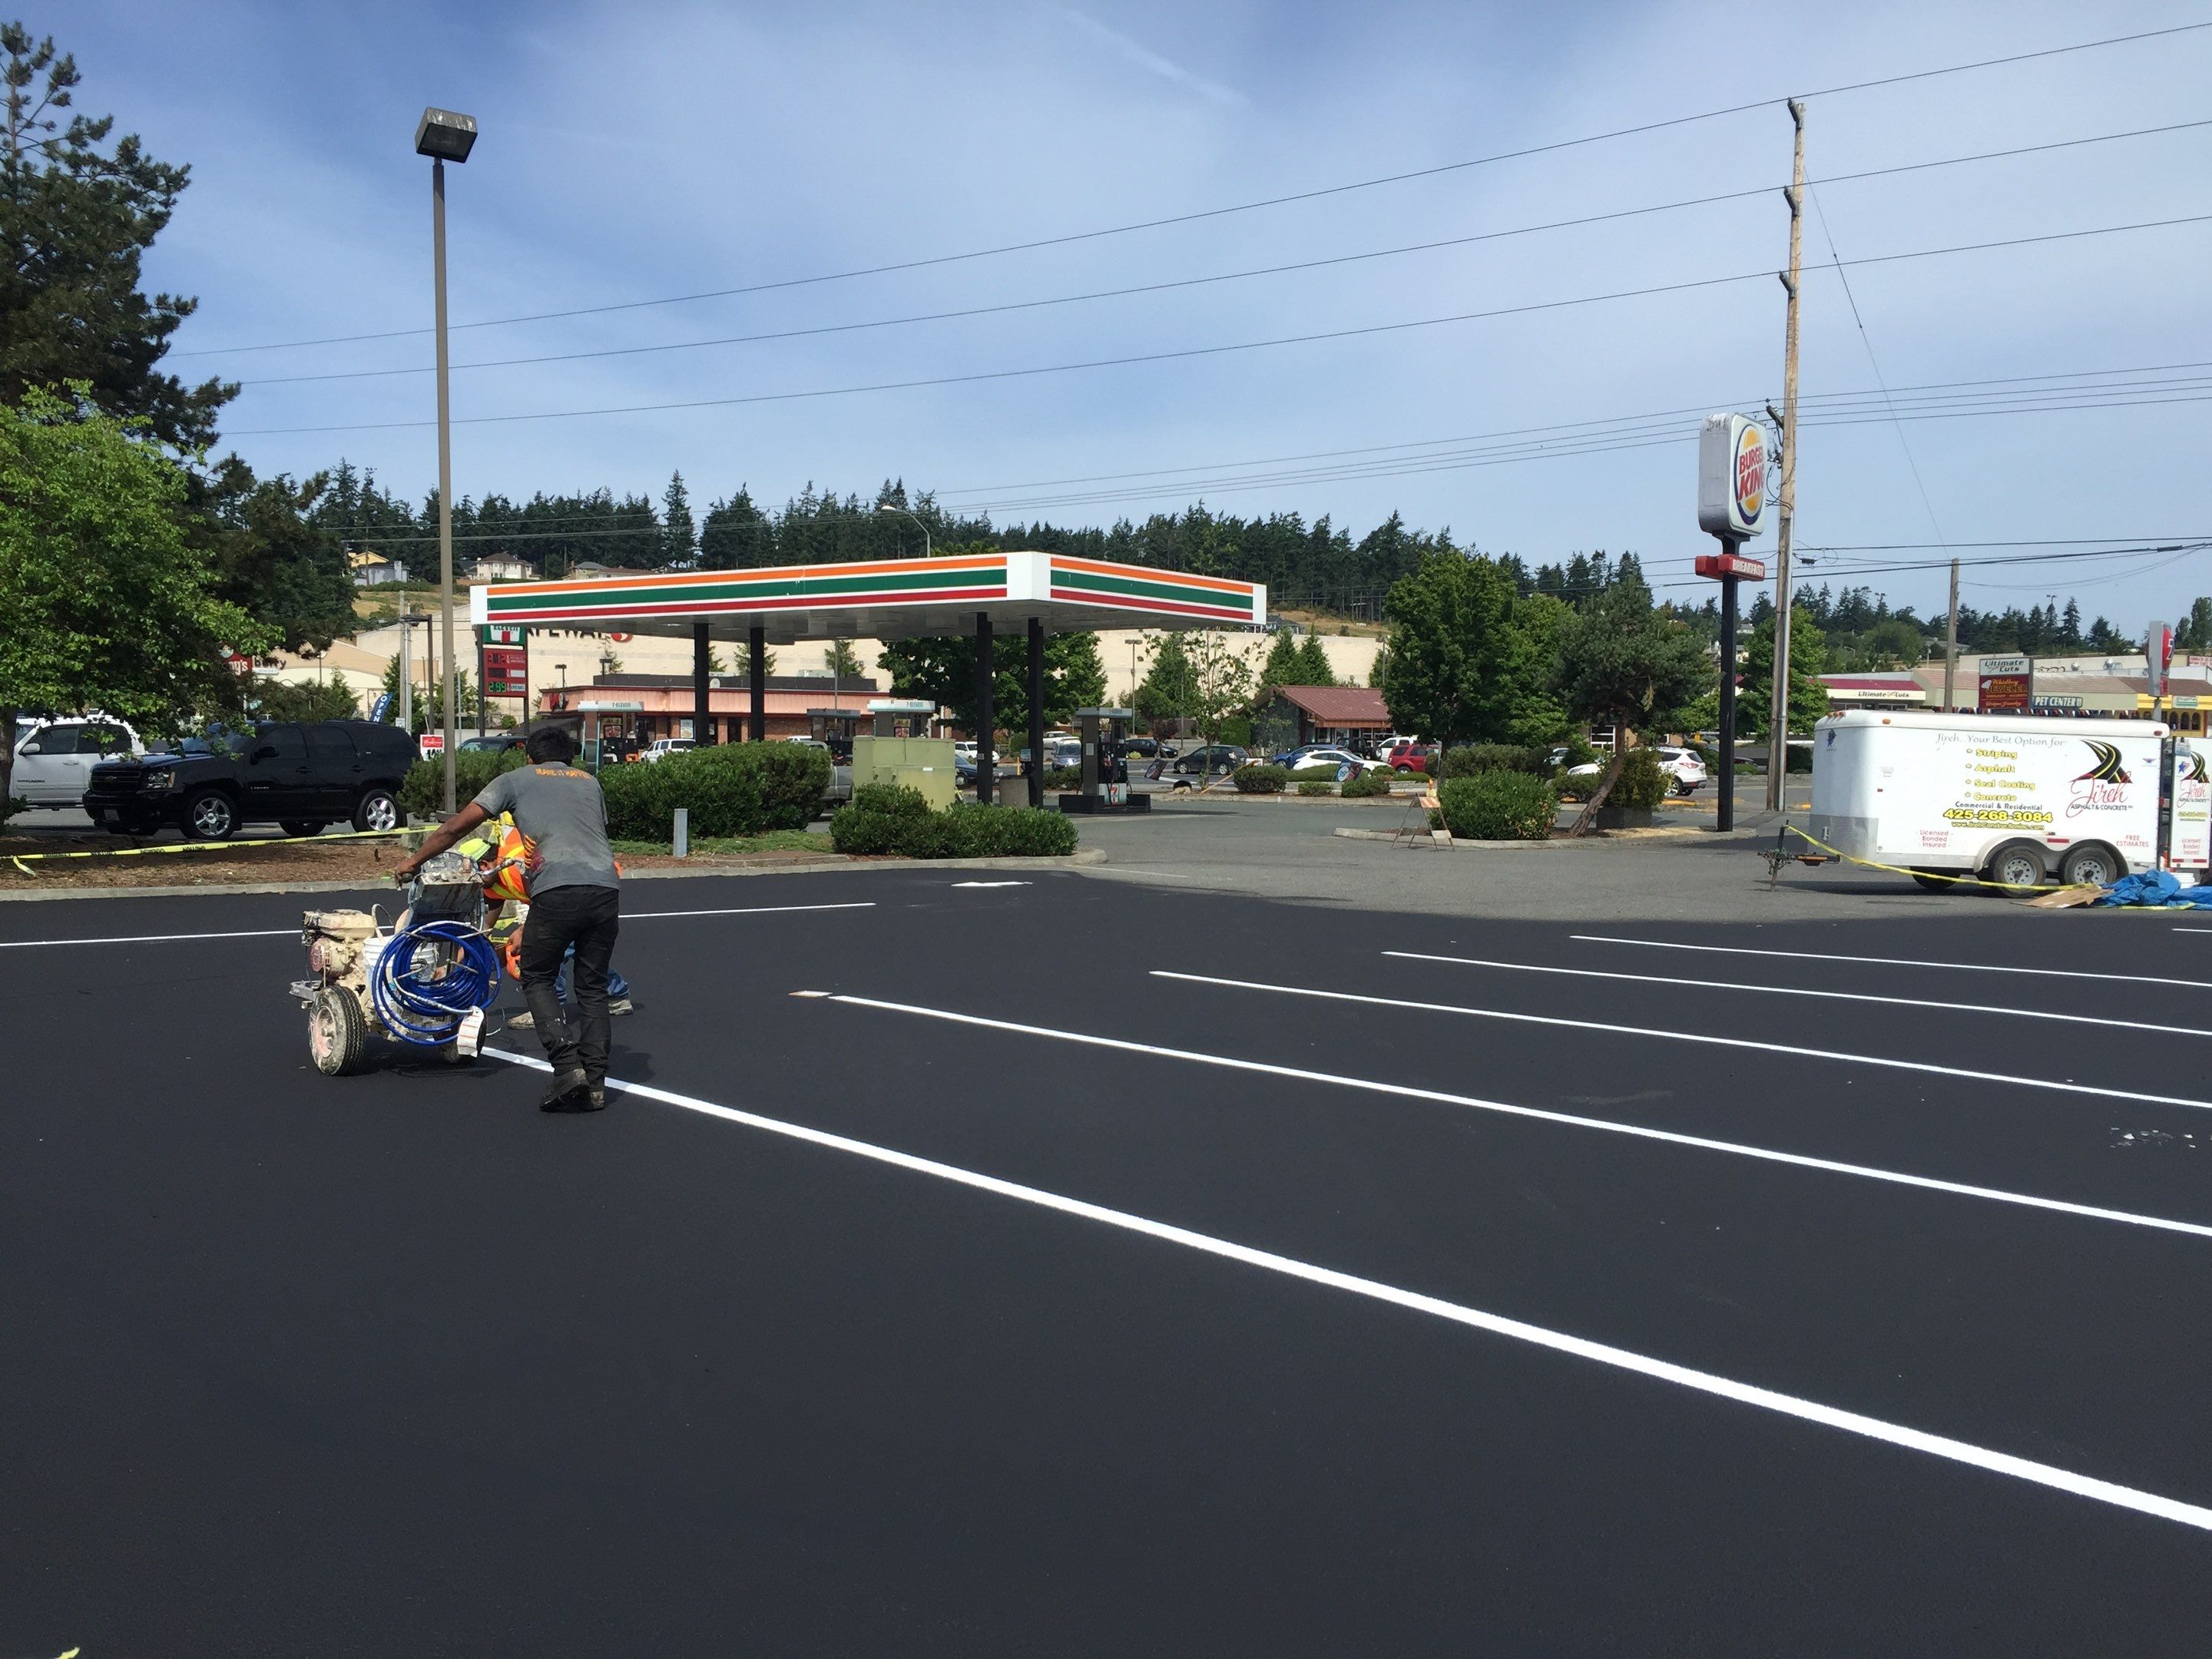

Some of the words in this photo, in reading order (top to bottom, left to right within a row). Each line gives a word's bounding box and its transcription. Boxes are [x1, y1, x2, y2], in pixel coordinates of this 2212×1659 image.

[2035, 697, 2049, 706] PET
[2049, 697, 2076, 707] CENTER
[373, 695, 388, 722] OPEN
[1967, 734, 1990, 743] Your
[1992, 735, 2012, 743] Best
[2015, 736, 2047, 747] Option
[1975, 749, 2017, 760] Striping
[1974, 763, 2015, 773] Asphalt
[1974, 779, 1995, 788] Seal
[1998, 780, 2037, 791] Coating
[1974, 792, 2017, 801] Concrete
[2066, 771, 2131, 818] Jireh
[1943, 808, 2054, 823] 425-268-3084
